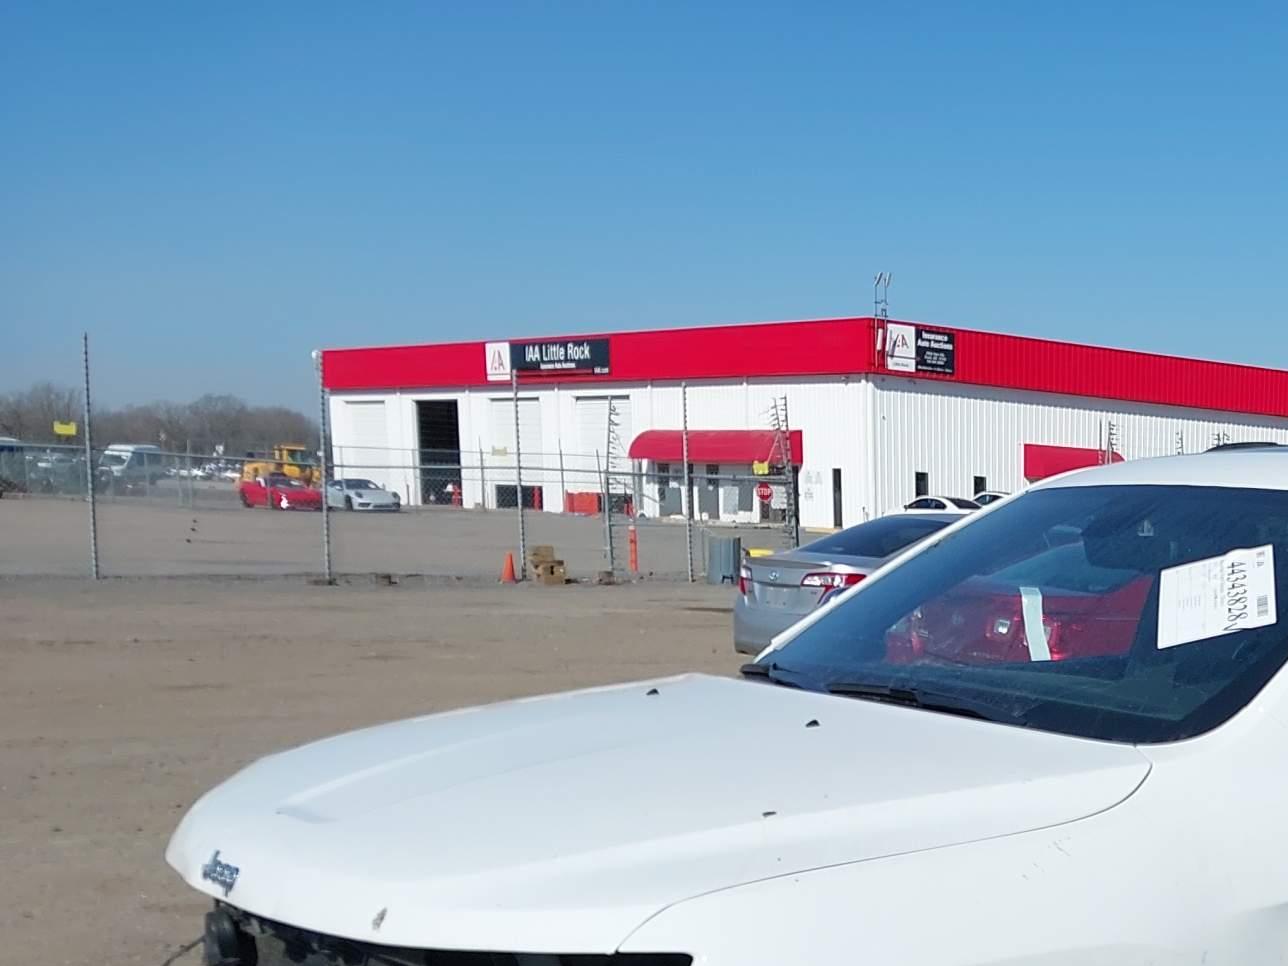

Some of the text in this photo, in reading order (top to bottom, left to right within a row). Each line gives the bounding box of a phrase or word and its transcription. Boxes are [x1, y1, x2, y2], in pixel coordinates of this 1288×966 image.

[542, 343, 565, 361] Little
[567, 342, 591, 360] Rock
[758, 488, 771, 496] STOP
